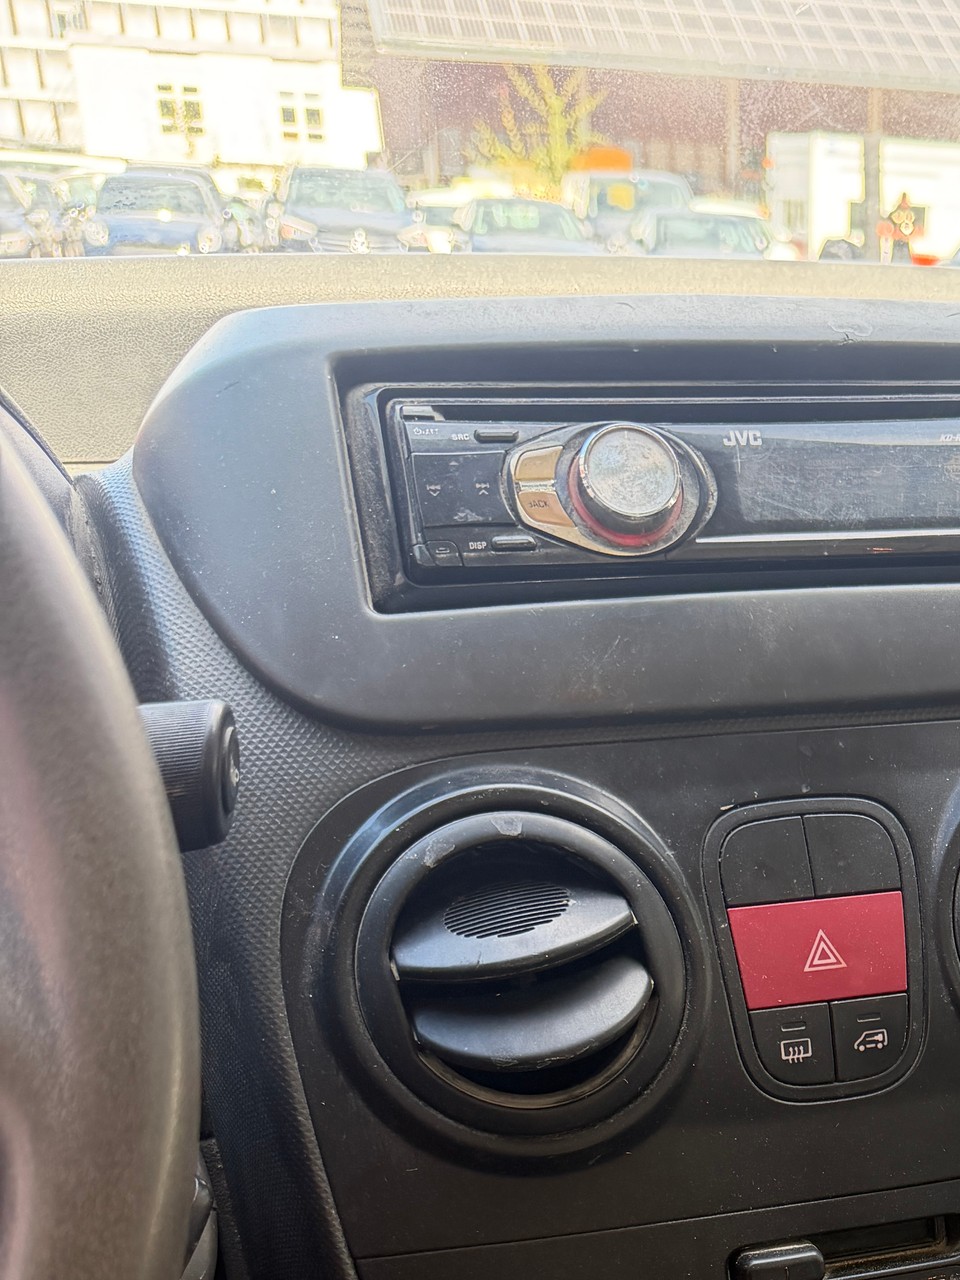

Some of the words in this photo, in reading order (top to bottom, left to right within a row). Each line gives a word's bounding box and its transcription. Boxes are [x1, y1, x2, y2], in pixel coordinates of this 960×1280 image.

[451, 433, 470, 441] SRC
[722, 429, 763, 446] JVC
[468, 541, 487, 550] DISP
